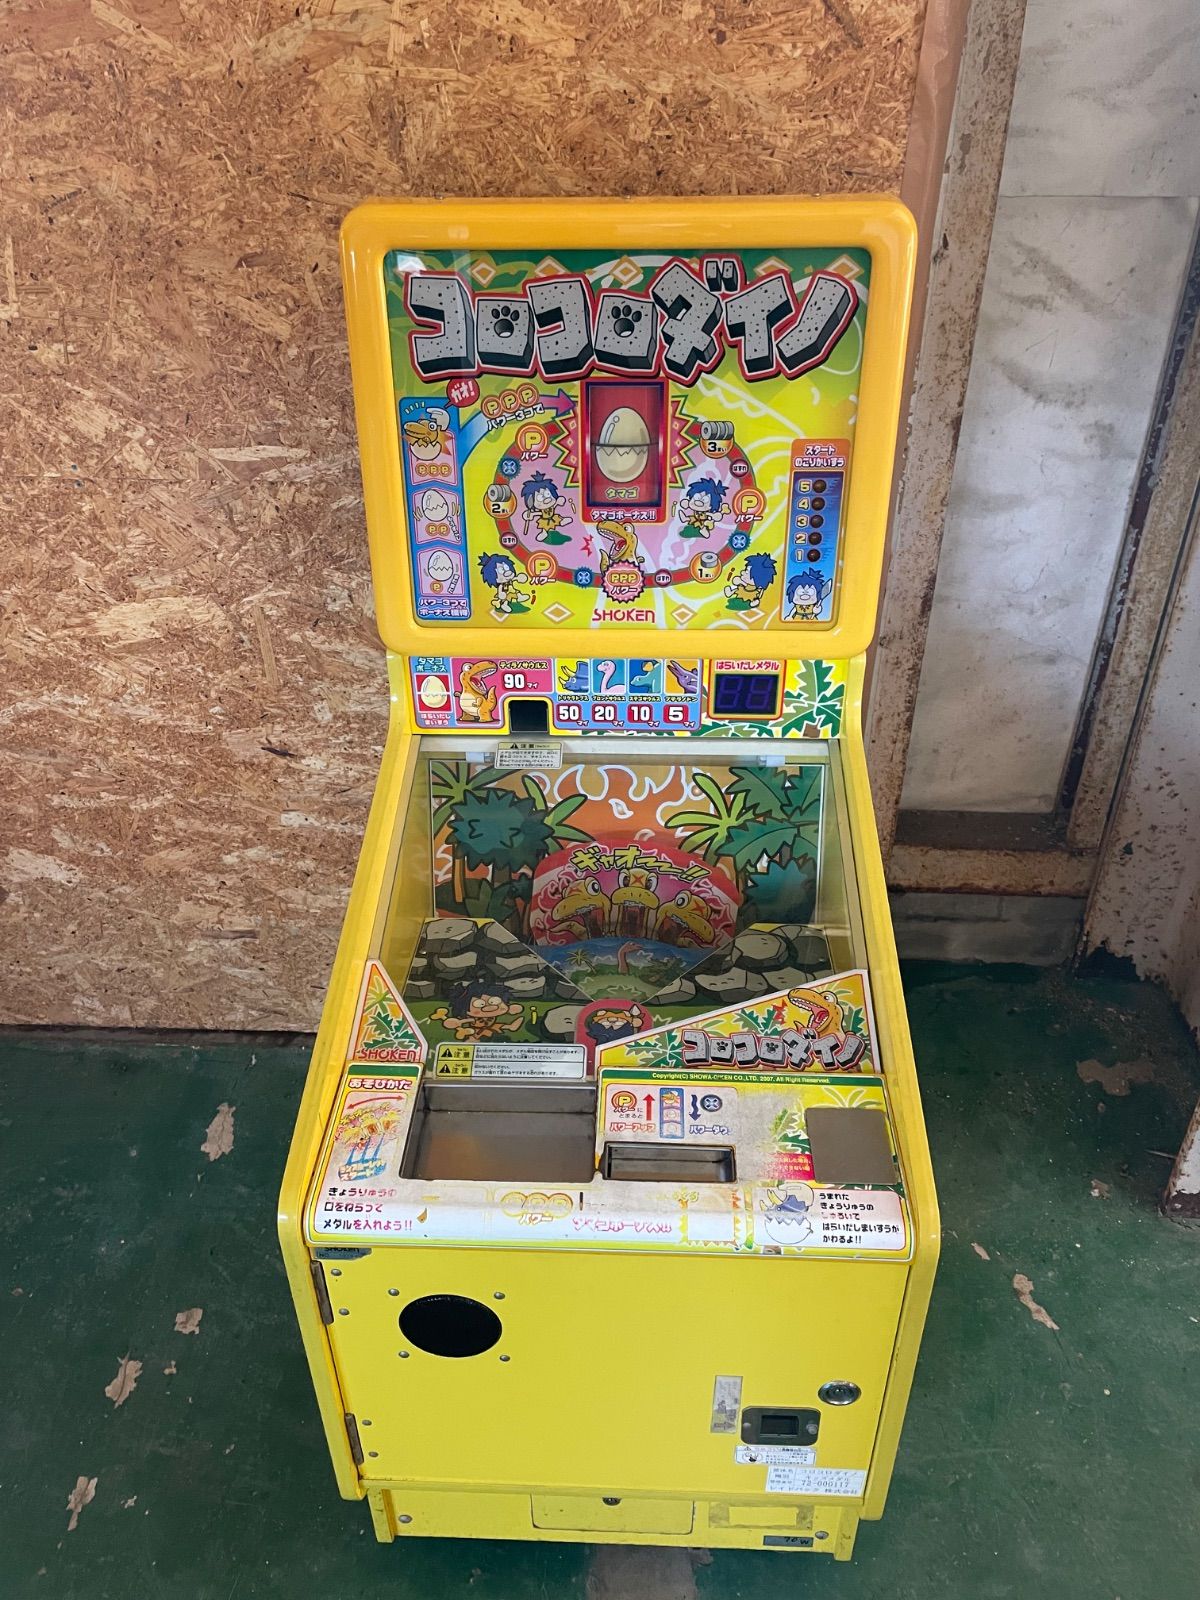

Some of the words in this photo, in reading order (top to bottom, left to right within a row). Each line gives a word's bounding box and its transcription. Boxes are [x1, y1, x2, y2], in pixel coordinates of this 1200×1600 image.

[405, 256, 856, 385] コロコロダイノ
[805, 445, 836, 456] スタート
[521, 452, 548, 461] パワー
[794, 458, 845, 468] のこりかいすう
[800, 481, 811, 493] 5
[606, 488, 639, 499] タマゴ
[798, 497, 809, 510] 4
[736, 515, 763, 523] パワー
[796, 516, 808, 528] 3
[795, 533, 806, 544] 2
[796, 550, 803, 561] 1
[530, 577, 556, 585] パワー
[611, 586, 637, 595] パワー
[499, 661, 548, 669] ティラノサウルス
[716, 661, 780, 671] はらいだしメダル
[504, 674, 525, 689] 90
[559, 706, 579, 720] 50
[595, 706, 615, 720] 20
[631, 706, 651, 721] 10
[669, 707, 684, 721] 5
[682, 1028, 866, 1070] コロコロダイノ
[349, 1079, 412, 1090] あそびかた
[610, 1122, 656, 1132] パワーアップ
[324, 1219, 412, 1230] メダルを入れよう!!
[822, 1223, 899, 1233] はらいだしまいすうが
